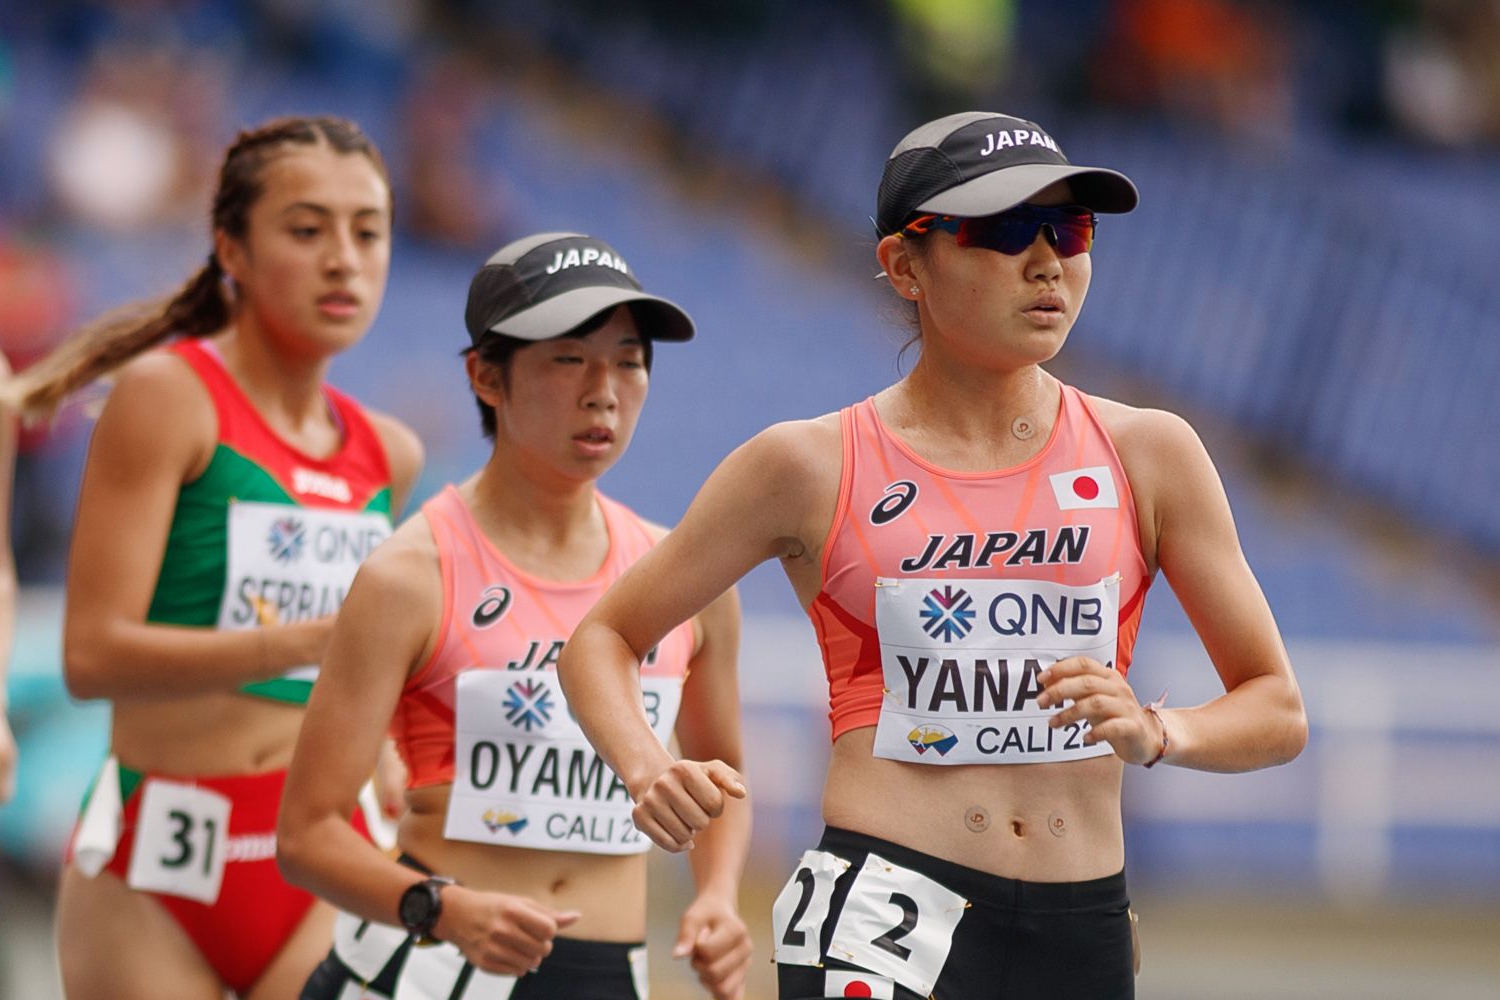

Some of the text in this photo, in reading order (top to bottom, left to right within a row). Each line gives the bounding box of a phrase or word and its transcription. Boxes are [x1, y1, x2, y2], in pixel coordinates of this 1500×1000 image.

[980, 129, 1058, 156] JAPAN
[546, 247, 628, 275] JAPAN
[900, 526, 1090, 571] JAPAN
[988, 592, 1102, 636] QNB
[976, 726, 1054, 755] CALI
[159, 810, 217, 880] 31
[546, 813, 615, 844] CALI
[782, 867, 816, 946] 2
[870, 892, 919, 961] 2
